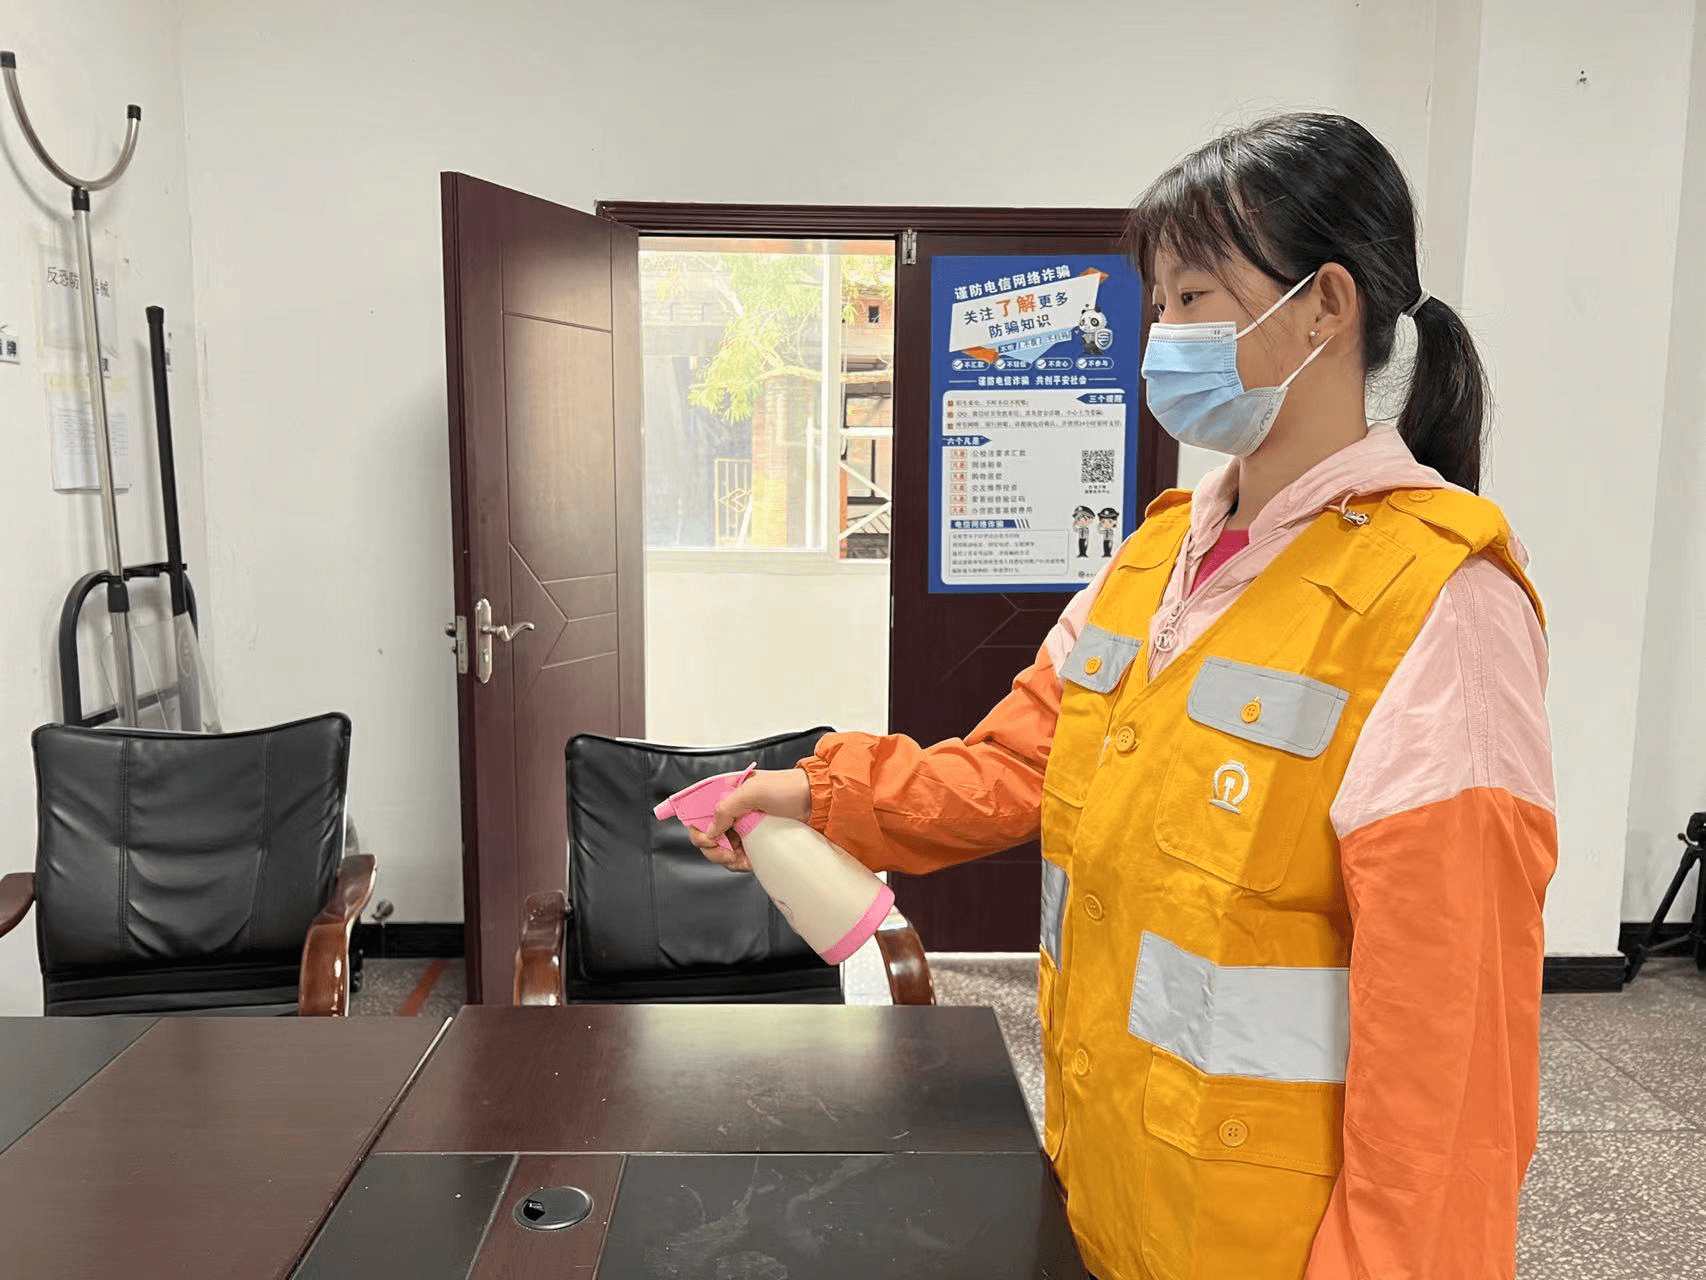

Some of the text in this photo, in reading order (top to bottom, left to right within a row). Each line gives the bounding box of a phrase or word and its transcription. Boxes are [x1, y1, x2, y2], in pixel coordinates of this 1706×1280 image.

[47, 266, 109, 297] 反恐防械
[954, 265, 1071, 299] 谨防电信网络诈骗
[964, 291, 1068, 325] 关注了解更多
[989, 314, 1051, 338] 防骗知识
[978, 375, 1087, 386] 谨防电信诈骗 共创平安社会
